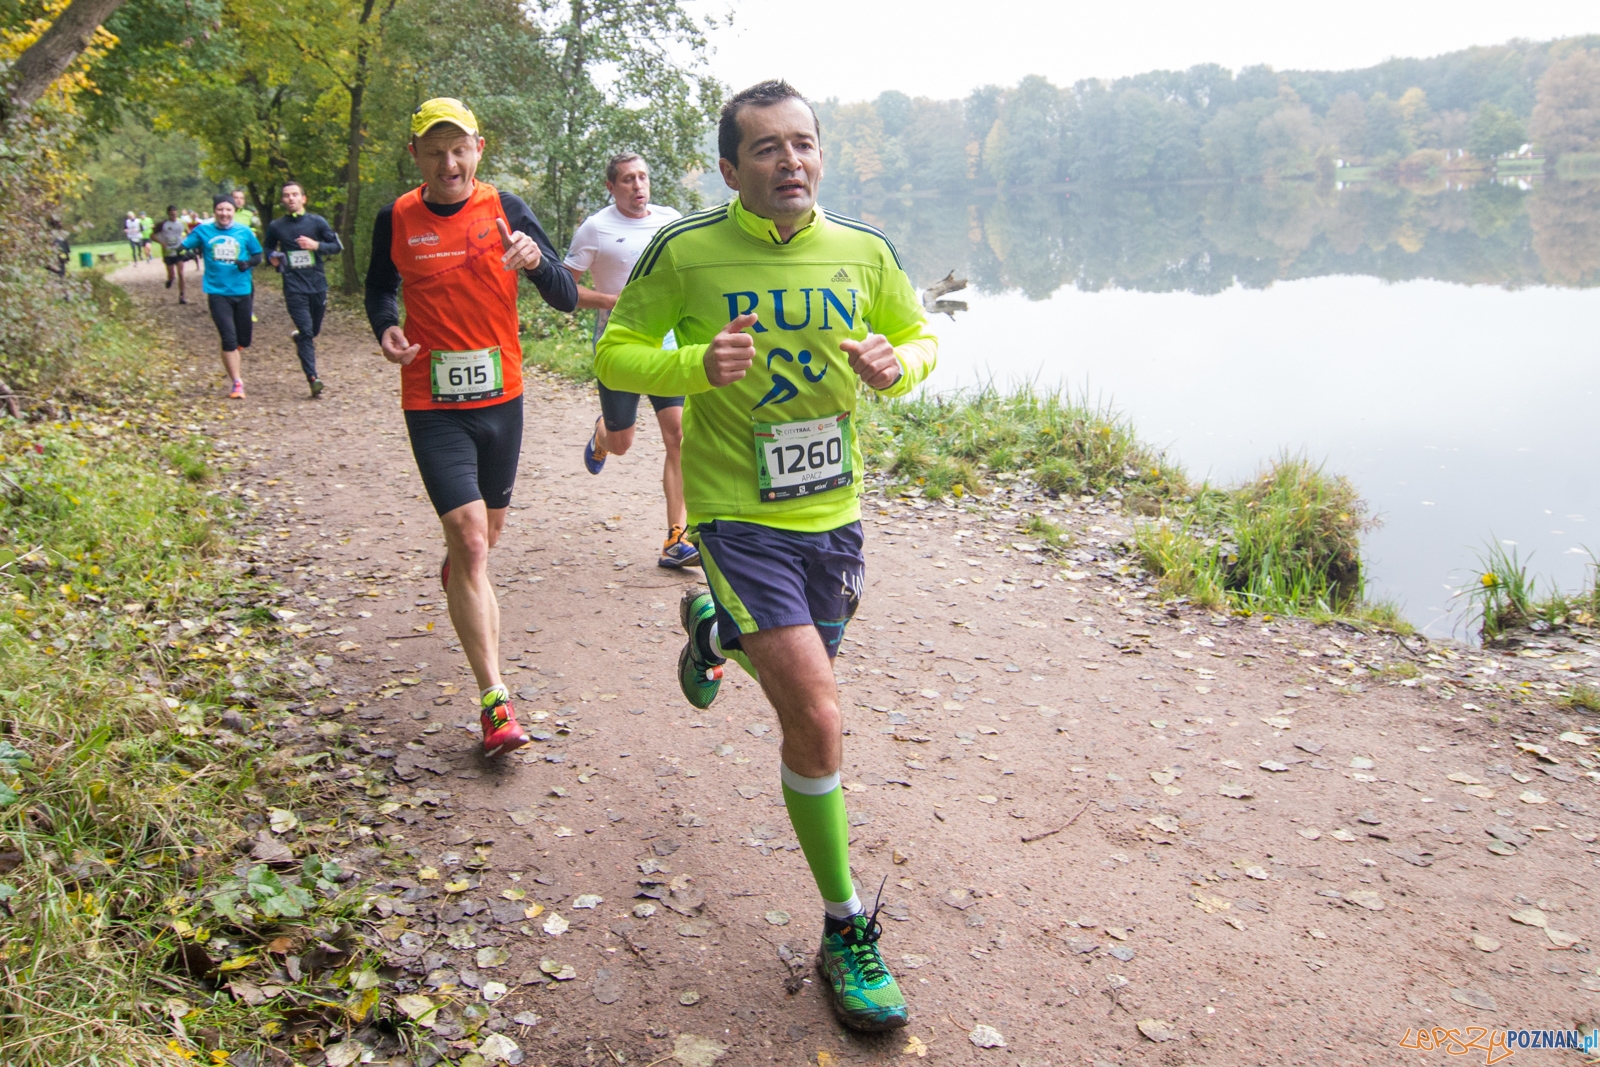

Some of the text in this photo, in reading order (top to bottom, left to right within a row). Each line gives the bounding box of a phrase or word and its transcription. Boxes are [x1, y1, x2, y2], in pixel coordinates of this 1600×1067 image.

[294, 255, 310, 263] 225
[722, 288, 858, 333] RUN
[448, 365, 487, 386] 615
[771, 436, 842, 475] 1260
[801, 471, 822, 481] APACZ
